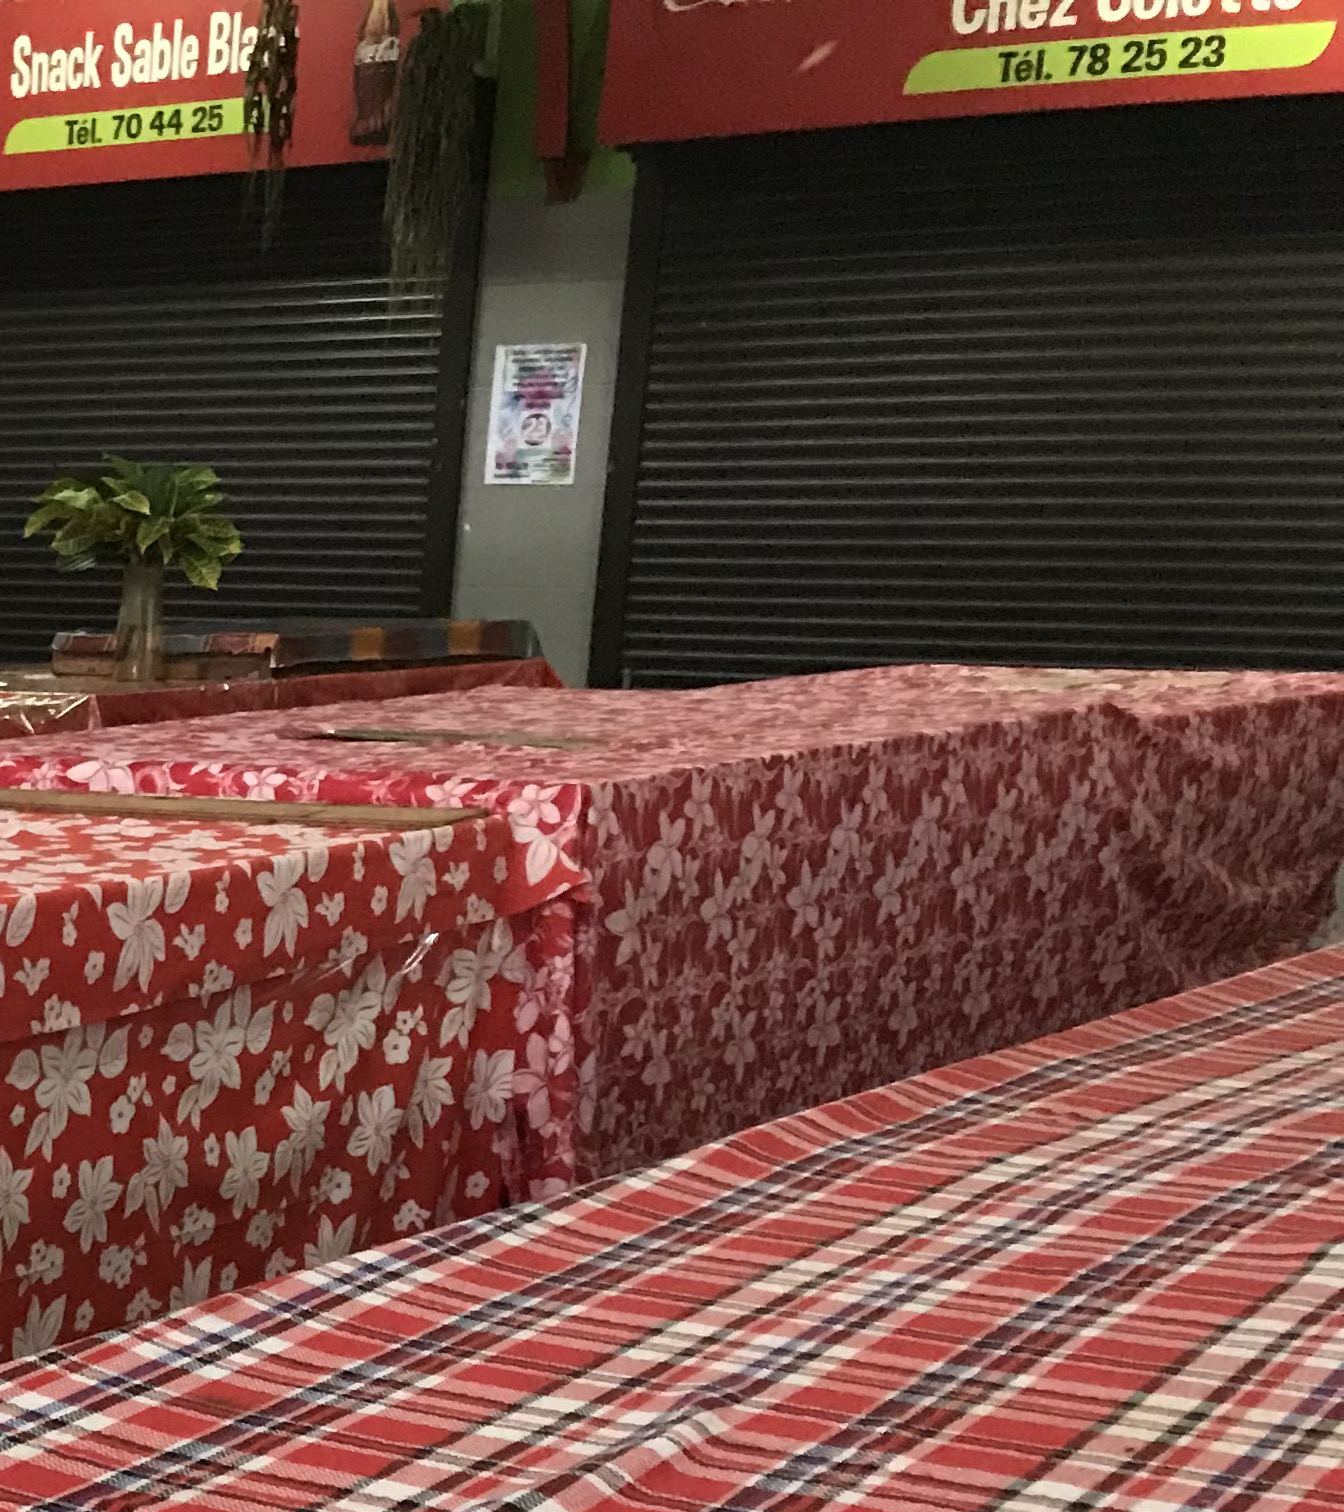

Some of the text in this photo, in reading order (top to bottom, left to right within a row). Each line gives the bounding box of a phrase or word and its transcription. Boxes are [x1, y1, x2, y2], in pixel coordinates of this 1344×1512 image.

[11, 31, 103, 97] Snack
[111, 18, 199, 87] Sable
[207, 11, 290, 75] Bla
[999, 34, 1227, 83] Tél. 78 25 23
[65, 104, 223, 145] Tél. 70 44 25
